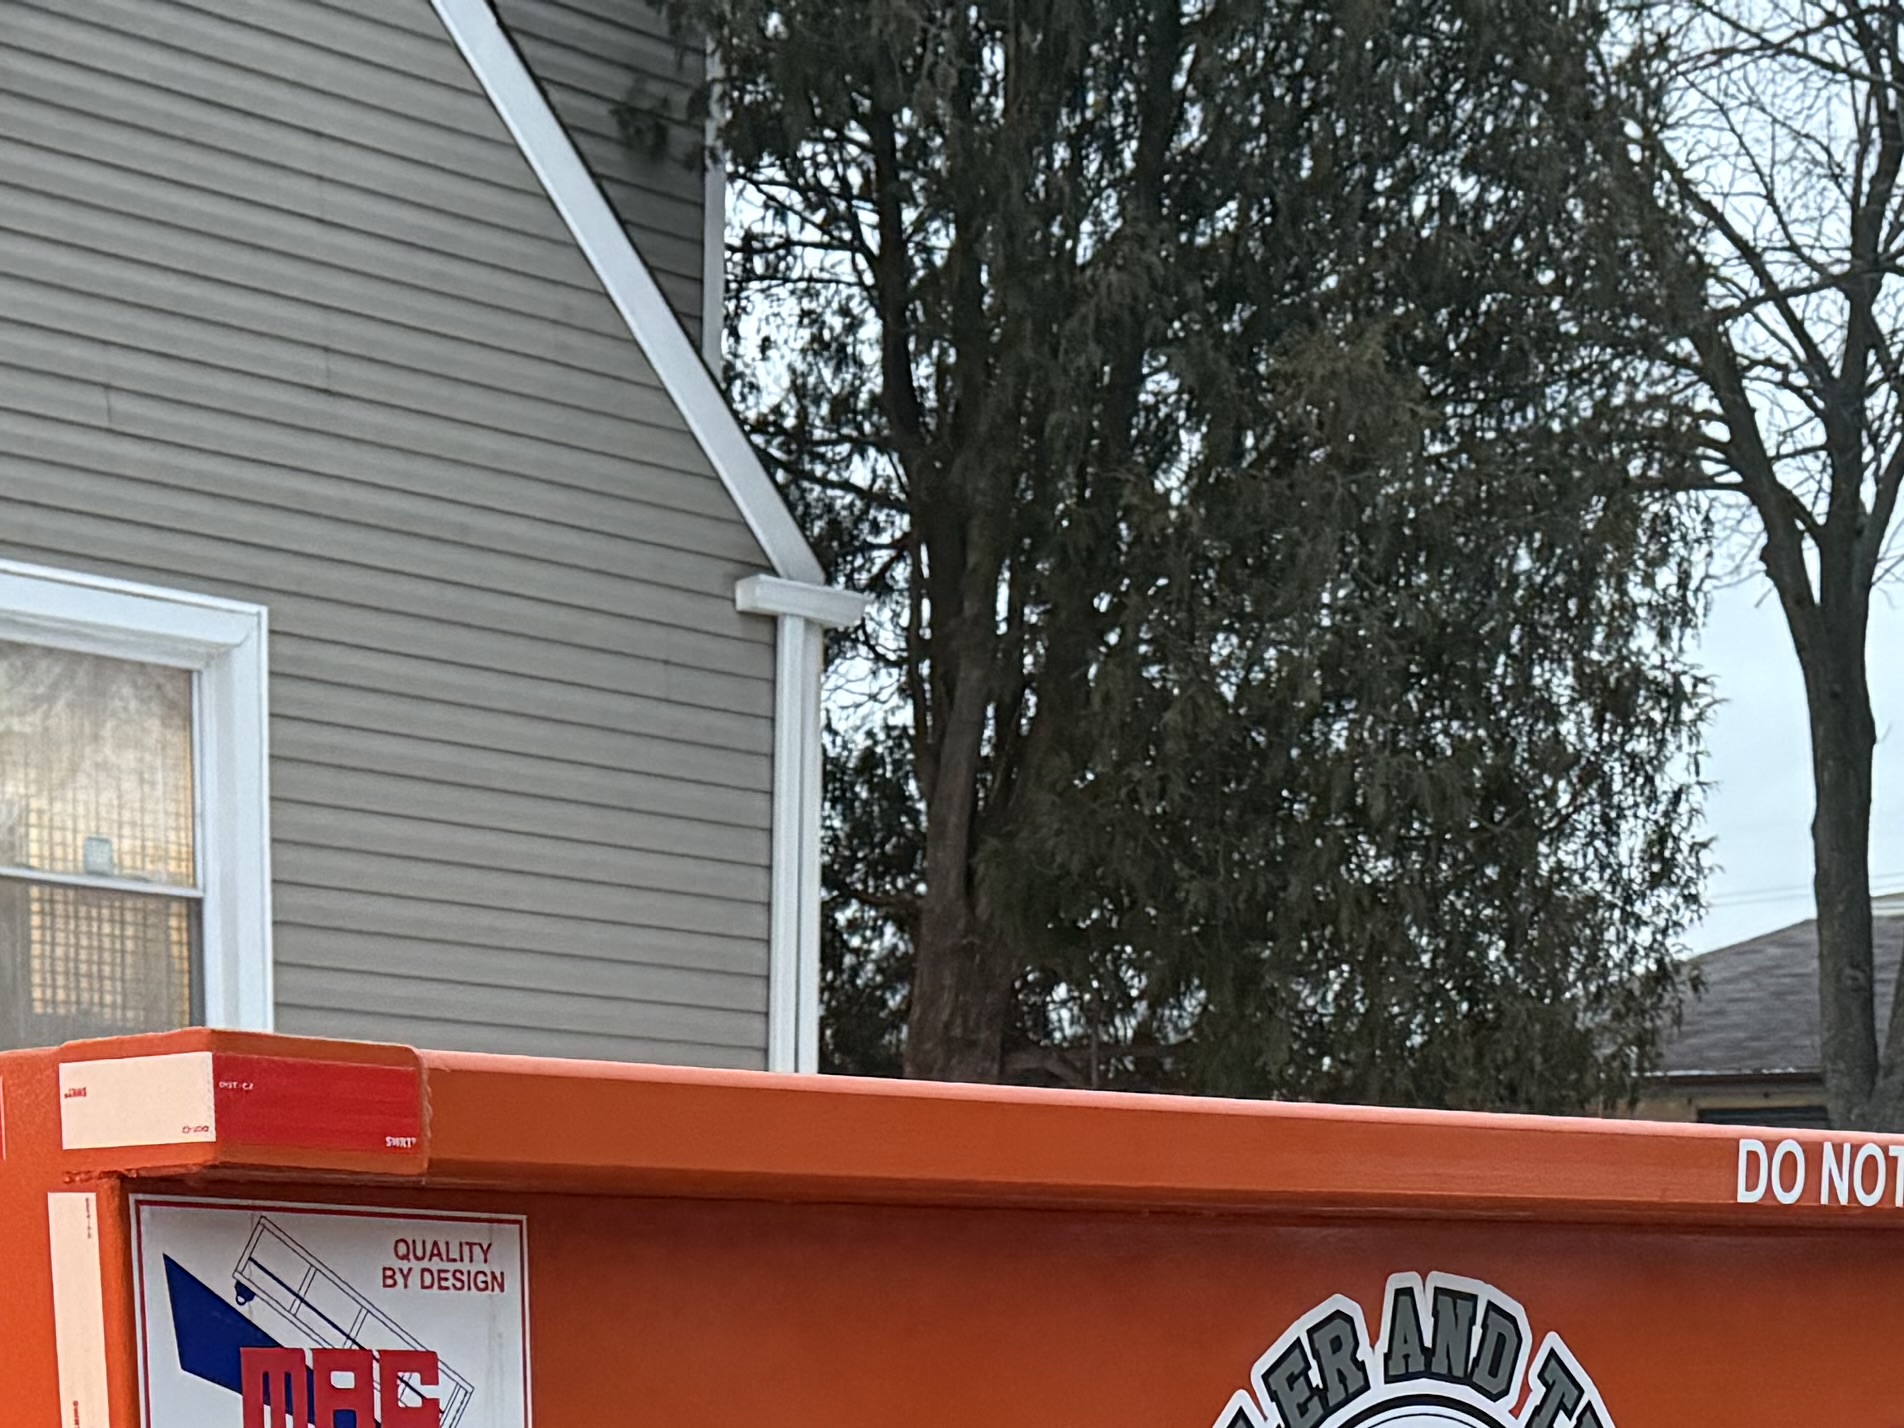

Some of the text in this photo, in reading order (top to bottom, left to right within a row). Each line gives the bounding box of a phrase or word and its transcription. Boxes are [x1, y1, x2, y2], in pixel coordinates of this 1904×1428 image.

[1737, 1139, 1806, 1205] DO
[393, 1238, 493, 1264] QUALITY
[382, 1267, 506, 1293] BY DESIGN
[1383, 1286, 1523, 1402] AND
